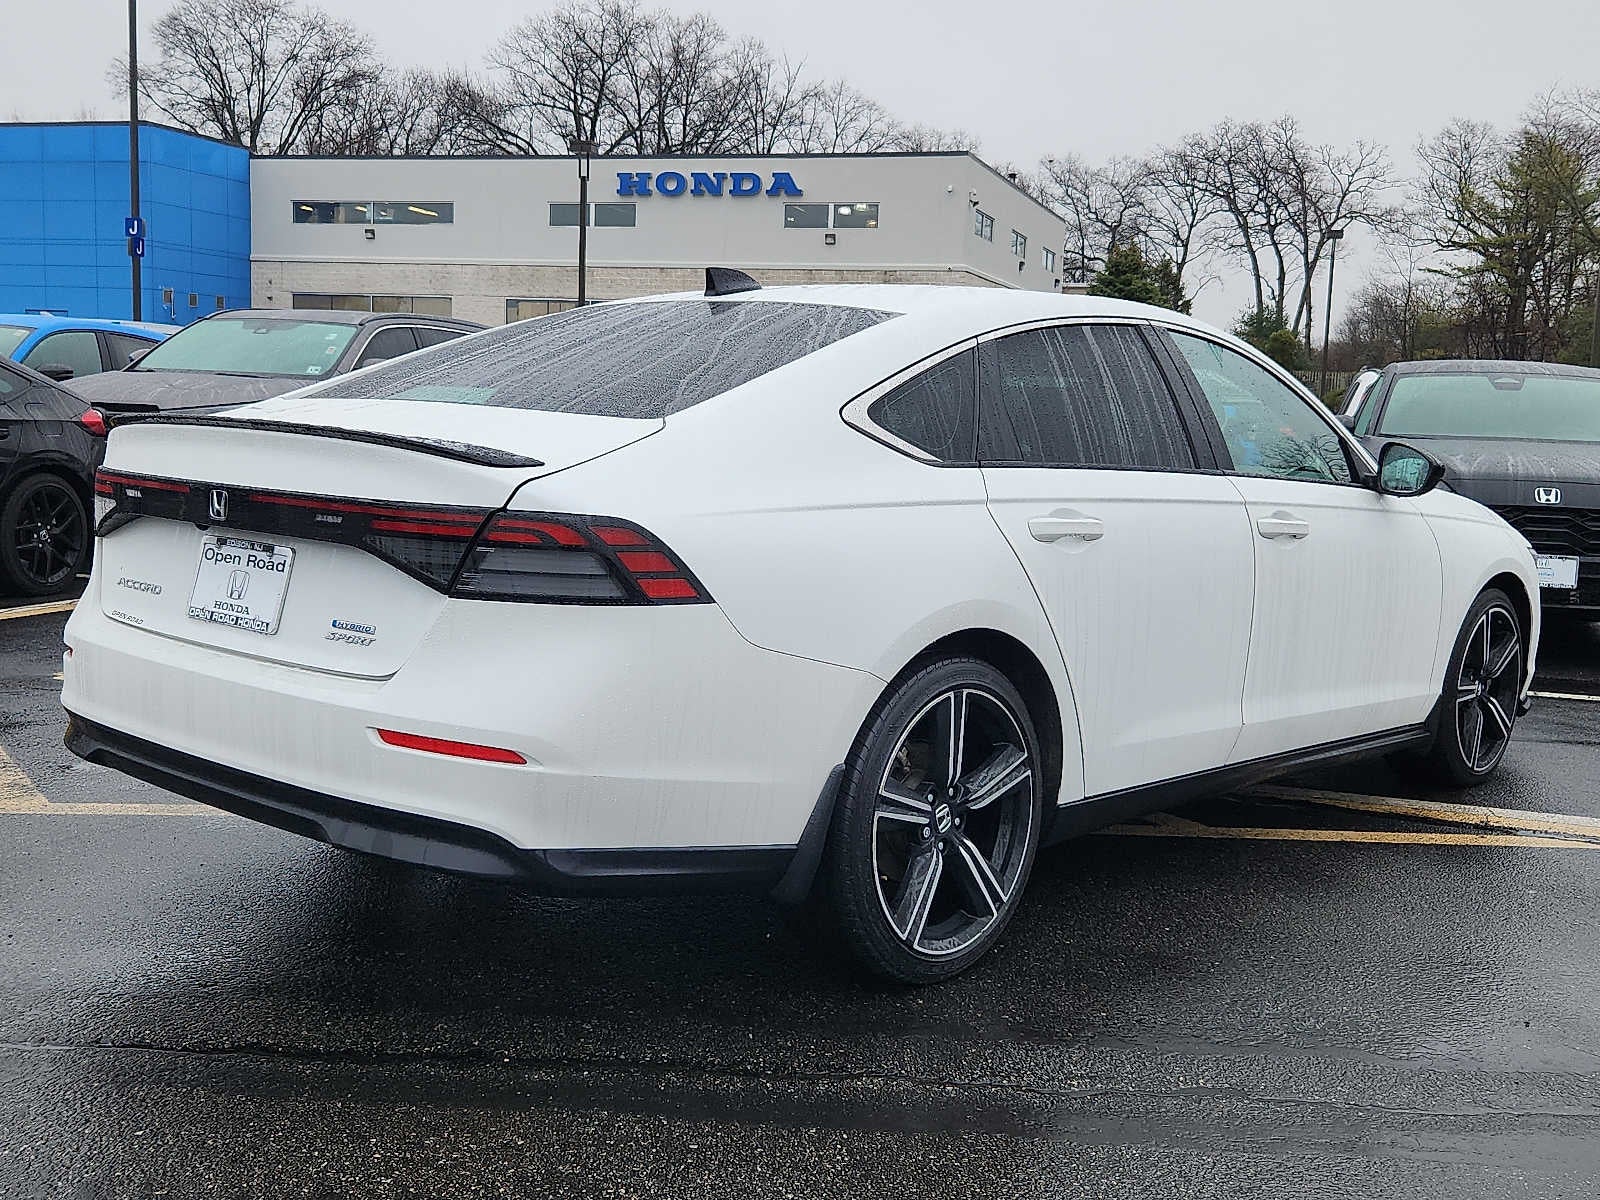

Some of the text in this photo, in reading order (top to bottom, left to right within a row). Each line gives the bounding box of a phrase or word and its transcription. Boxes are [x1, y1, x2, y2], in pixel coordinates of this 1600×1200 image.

[616, 171, 804, 197] HONDA
[129, 220, 138, 235] J
[136, 239, 143, 255] J
[204, 547, 287, 573] Open Road
[117, 577, 162, 595] ACCORD
[213, 600, 251, 616] HONDA
[189, 606, 269, 632] OPEN ROAD HONDA
[337, 621, 372, 632] HYBRID
[325, 632, 376, 647] SPORT
